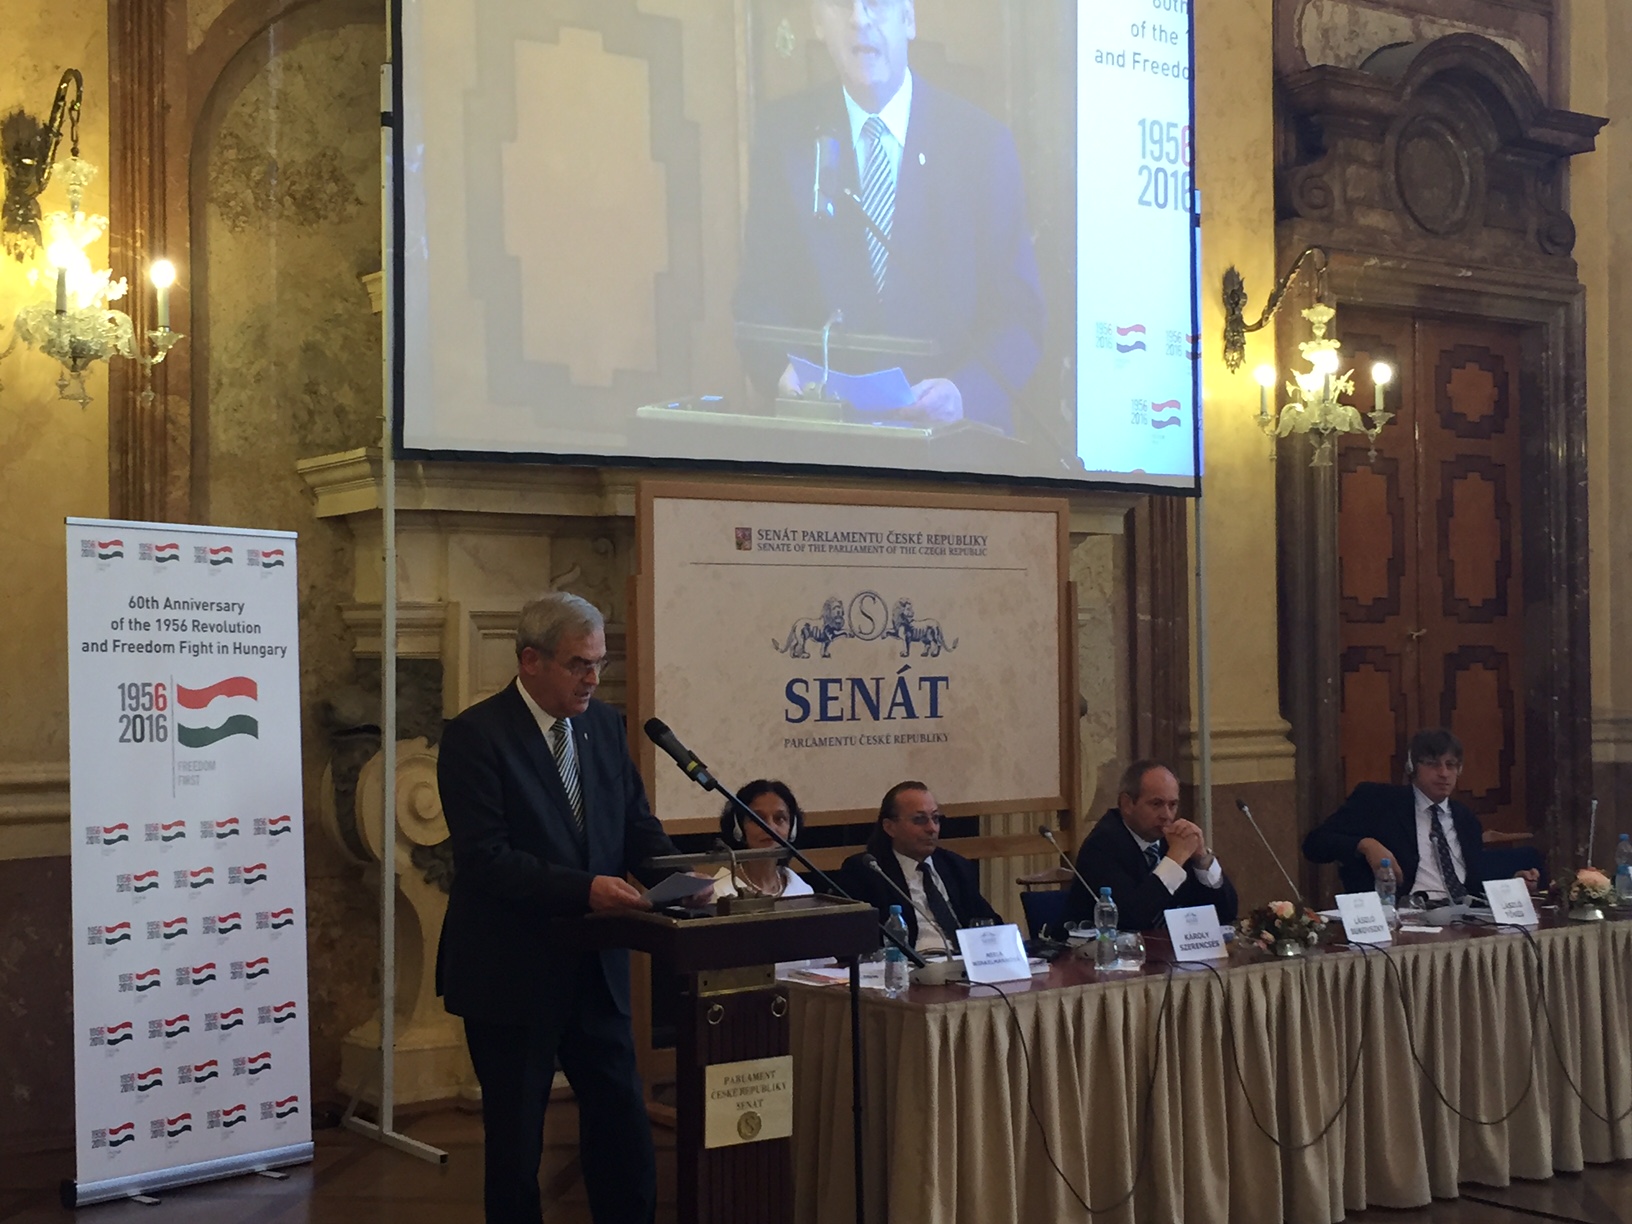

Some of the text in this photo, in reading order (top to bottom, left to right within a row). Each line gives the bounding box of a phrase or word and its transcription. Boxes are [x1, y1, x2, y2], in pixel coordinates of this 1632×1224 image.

[1131, 21, 1178, 45] of the
[1095, 49, 1125, 68] and
[1138, 118, 1191, 167] 1956
[1138, 165, 1192, 213] 2016
[757, 527, 798, 542] SENÁT
[802, 530, 884, 544] PARLAMENTU
[926, 534, 988, 547] REPUBLIKY
[757, 543, 988, 557] SENATE OF THE PARLIAMENT OF THE CZECH REPUBLIC
[128, 596, 245, 616] 60th Anniversary
[111, 618, 262, 634] of the 1956 Revolution
[81, 639, 287, 659] and Freedom Fight in Hungary
[118, 682, 168, 712] 1956
[785, 664, 949, 724] SENÁT
[118, 714, 168, 743] 2016
[784, 735, 857, 749] PARLAMENTU
[894, 733, 949, 745] REPUBLIKY
[177, 760, 217, 772] FREEDOM
[178, 775, 201, 786] FIRST
